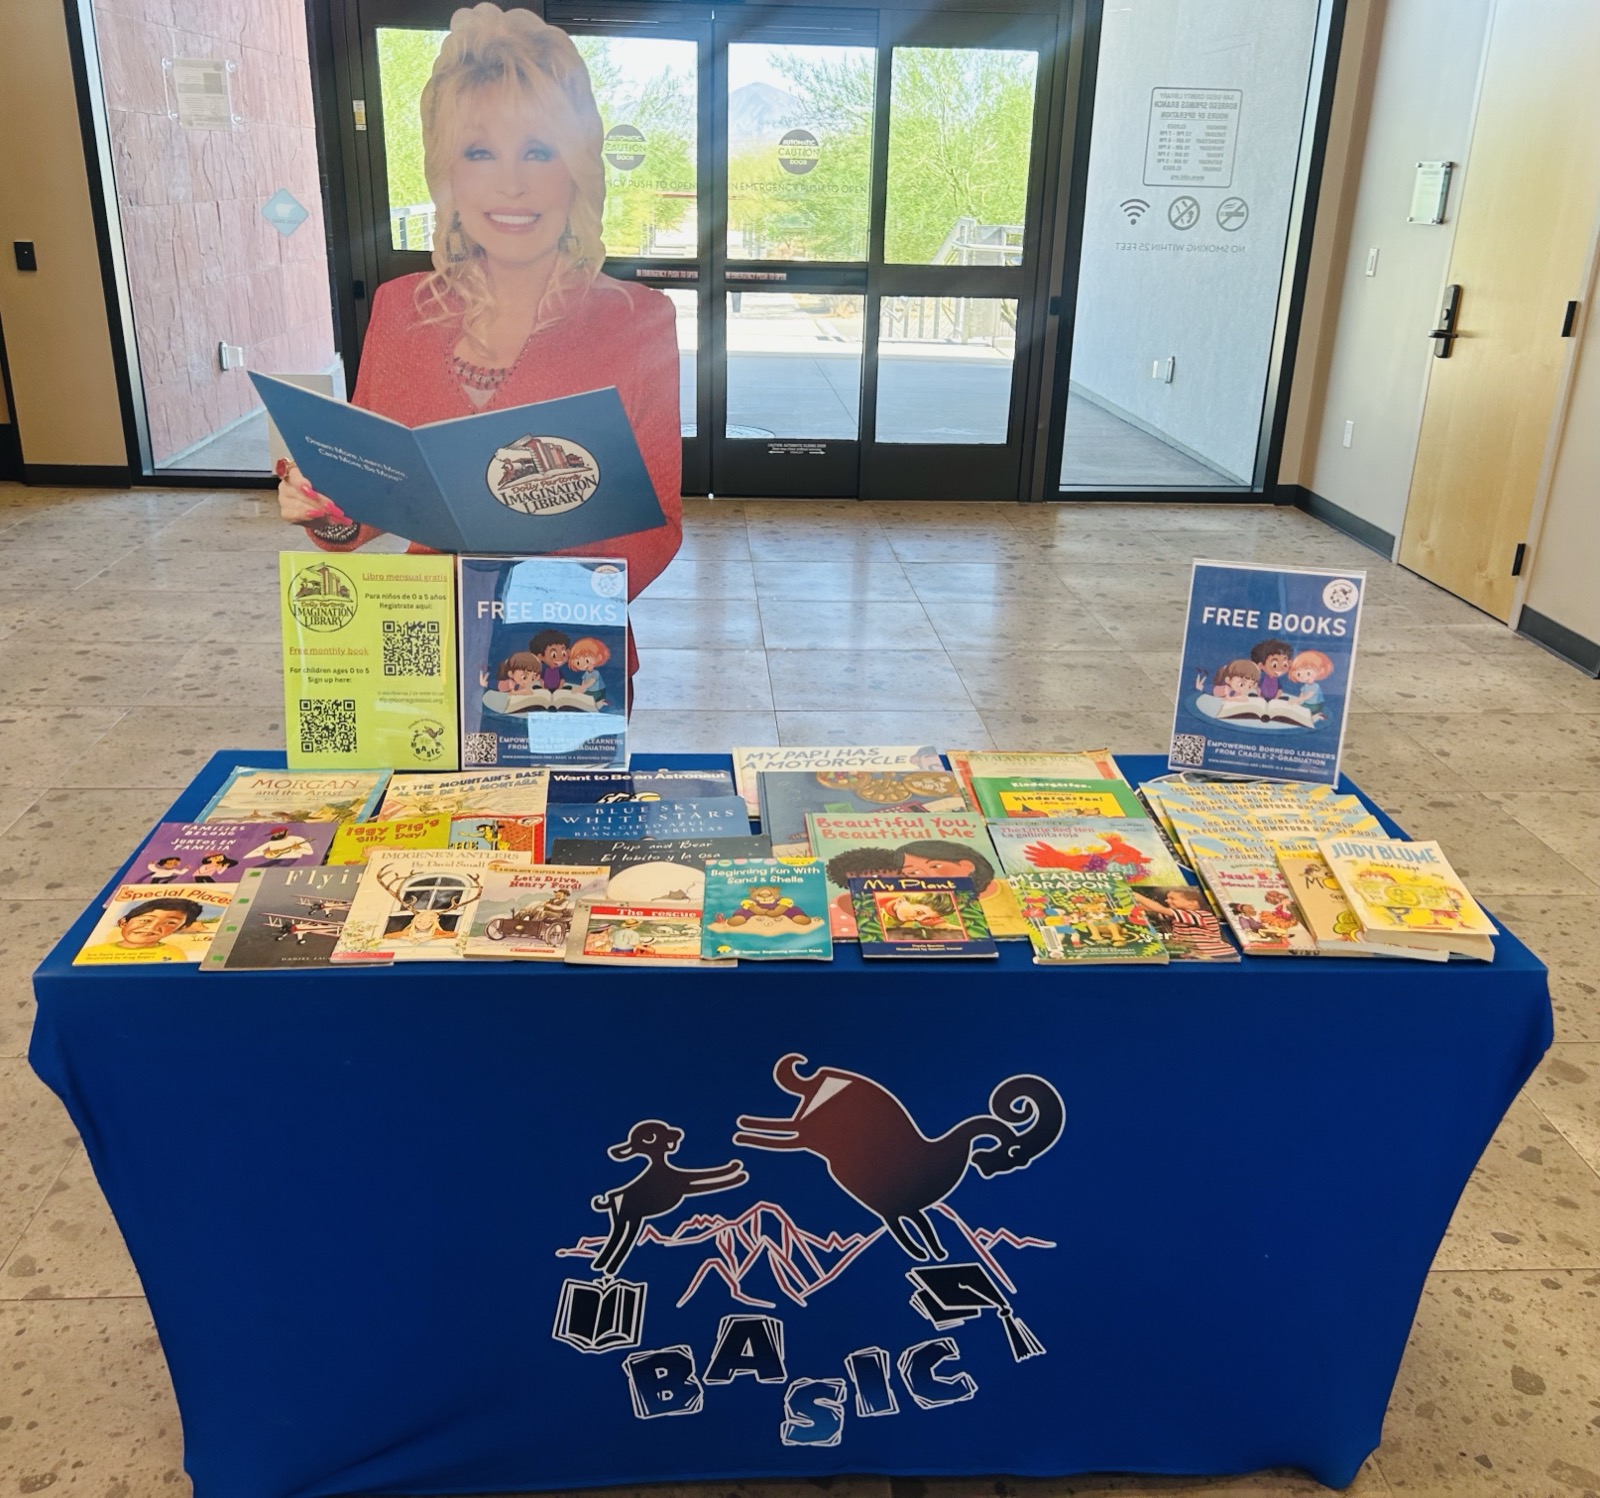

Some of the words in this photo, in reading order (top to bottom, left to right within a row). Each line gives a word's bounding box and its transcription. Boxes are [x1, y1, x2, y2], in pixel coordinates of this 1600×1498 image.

[604, 143, 646, 152] CAUTION
[778, 148, 820, 157] CAUTION
[740, 182, 800, 192] EMERGENCY
[801, 184, 824, 193] PUSH
[500, 474, 598, 507] IMAGINATION
[511, 481, 540, 494] Dolly
[524, 490, 586, 514] LIBRARY
[362, 573, 384, 581] Libro
[386, 574, 422, 582] mensual
[424, 574, 447, 583] gratis
[293, 604, 354, 617] IMAGINATION
[477, 601, 533, 620] FREE
[542, 603, 617, 622] BOOKS
[305, 616, 344, 627] LIBRARY
[1202, 606, 1260, 629] FREE
[1268, 612, 1347, 636] BOOKS
[289, 647, 308, 655] Free
[310, 647, 346, 656] monthly
[745, 752, 781, 762] MY
[784, 750, 830, 760] PAPI
[837, 748, 881, 756] HAS
[1207, 740, 1257, 752] EMPOWERING
[1259, 746, 1295, 755] BORREGO
[1297, 750, 1336, 760] LEARNERS
[1215, 748, 1236, 756] FROM
[741, 762, 758, 770] A
[763, 755, 908, 769] MOTORCYCLE
[250, 779, 360, 789] MORGAN
[439, 773, 511, 788] MOUNTAIN'S
[515, 770, 545, 778] BASE
[660, 803, 701, 811] SKY
[561, 816, 648, 824] WHITE
[658, 809, 734, 820] STARS
[346, 826, 390, 836] Iggy
[395, 819, 440, 833] Pig's
[817, 817, 924, 828] Beautiful
[930, 818, 977, 828] You,
[394, 829, 427, 840] Day!
[646, 826, 723, 835] ESTRELLAS
[822, 829, 932, 839] Beautiful
[939, 829, 976, 839] Me
[612, 842, 640, 851] Pup
[680, 840, 713, 849] Bear
[460, 852, 520, 860] ANTLERS
[600, 854, 617, 862] El
[1331, 842, 1376, 859] JUDY
[1378, 845, 1440, 864] BLUME
[711, 867, 767, 877] Beginning
[1040, 872, 1123, 880] FATHER'S
[1218, 871, 1255, 880] Junie
[727, 876, 757, 884] Sand
[863, 879, 895, 891] My
[899, 879, 957, 890] Plant
[120, 888, 184, 900] Special
[616, 908, 644, 917] The
[652, 910, 697, 918] rescue
[622, 1314, 978, 1446] BASIC
